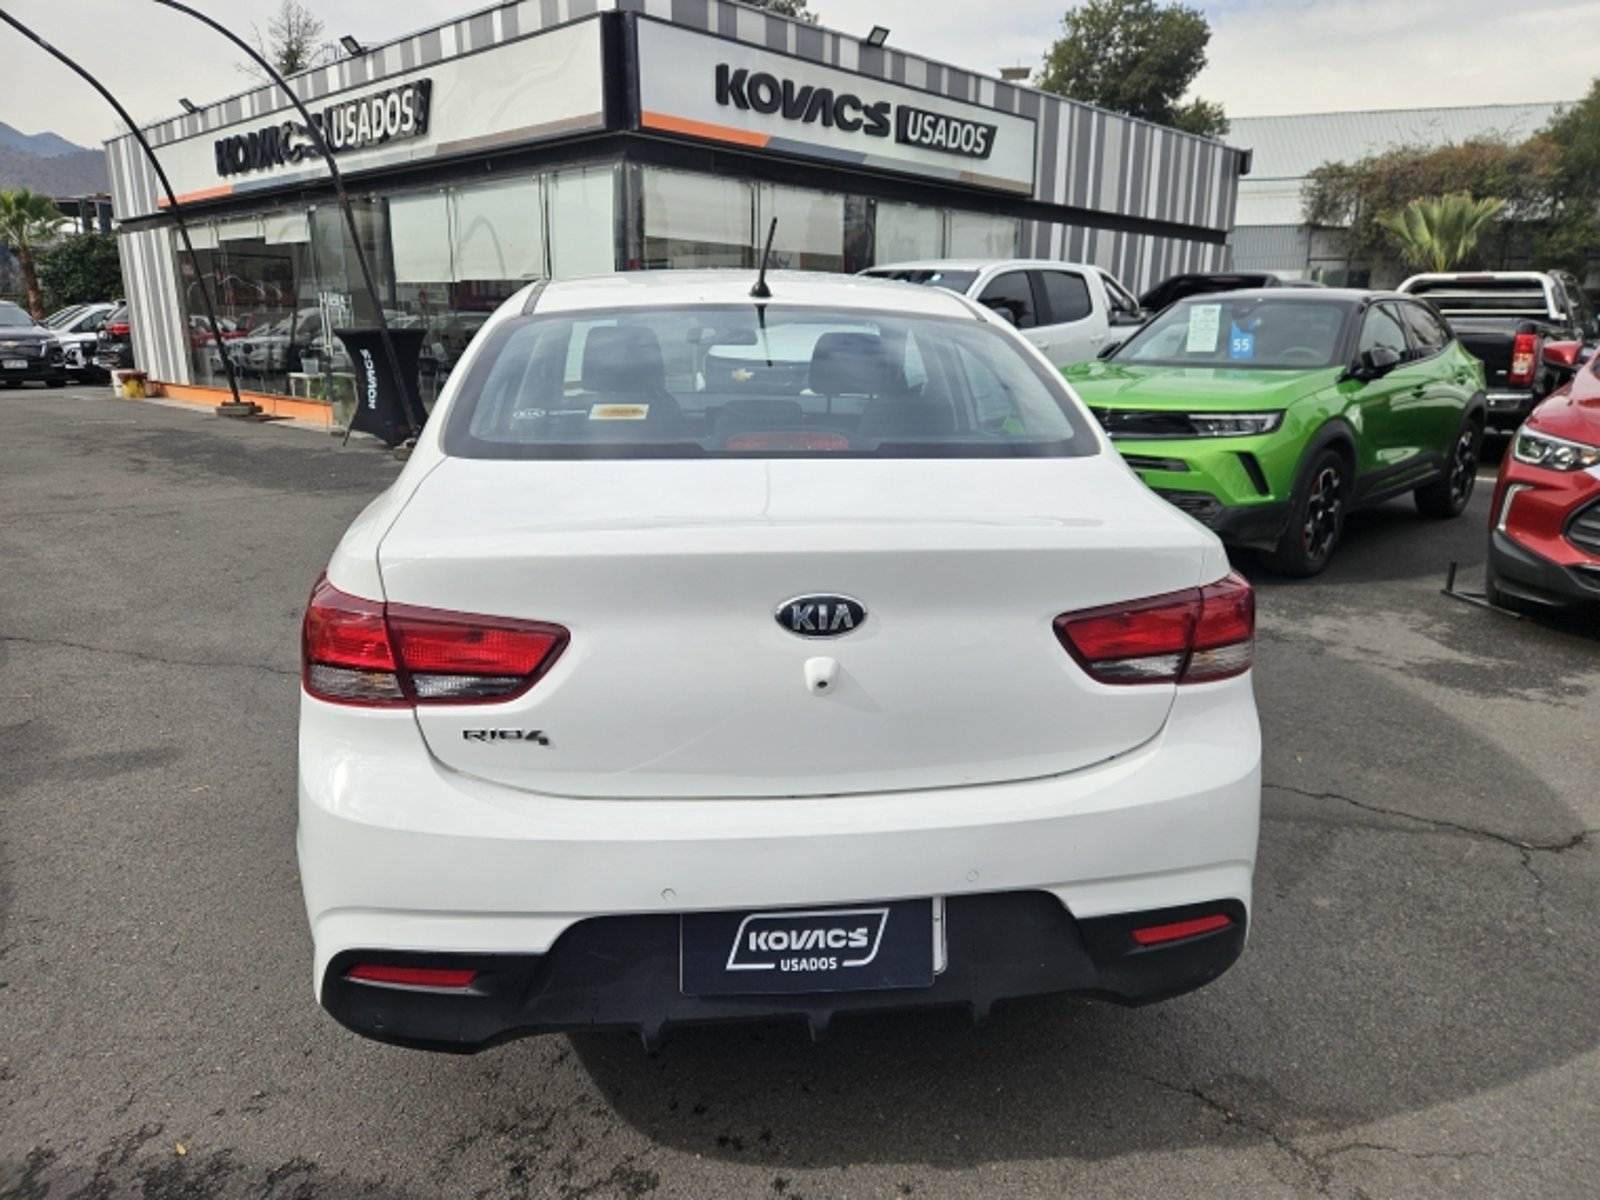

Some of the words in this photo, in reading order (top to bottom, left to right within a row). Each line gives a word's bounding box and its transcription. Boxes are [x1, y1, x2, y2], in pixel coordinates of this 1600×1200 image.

[332, 88, 415, 149] USADOS
[715, 63, 891, 138] KOVACS
[907, 110, 988, 154] USADOS
[1233, 338, 1249, 352] 55
[791, 603, 854, 630] KIA
[749, 927, 869, 951] KOVACS
[780, 957, 837, 972] USADOS
